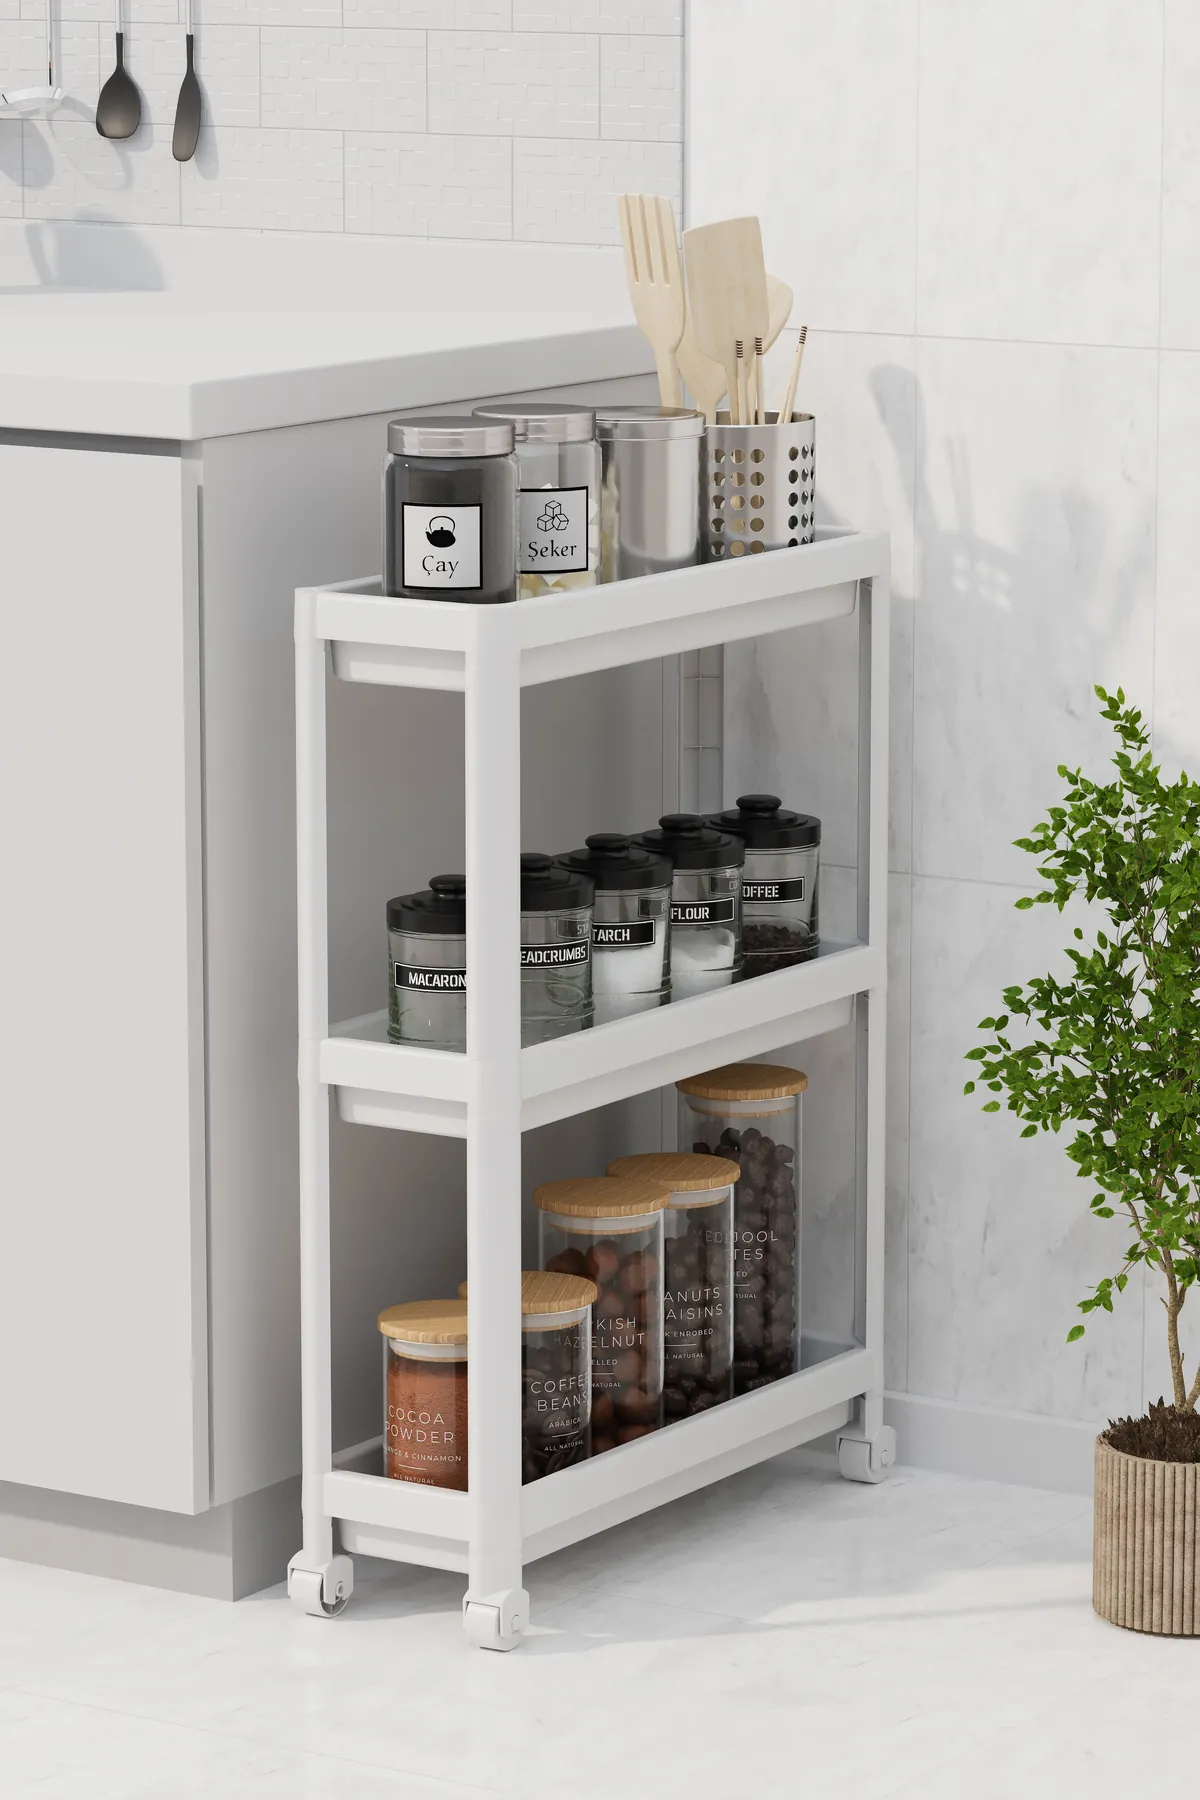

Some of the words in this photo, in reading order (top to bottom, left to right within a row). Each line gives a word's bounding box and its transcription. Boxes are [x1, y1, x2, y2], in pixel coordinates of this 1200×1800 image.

[528, 540, 577, 561] Şeker
[422, 555, 459, 578] Çay
[742, 885, 779, 898] OFFEE
[671, 907, 709, 920] FLOUR
[592, 928, 630, 942] TARCH
[520, 945, 586, 964] EADCRUMBS
[734, 1248, 763, 1260] TES
[664, 1286, 720, 1303] ANUTS
[665, 1303, 723, 1320] AISINS
[673, 1328, 714, 1338] ENROBED
[537, 1390, 588, 1412] BEANS
[388, 1405, 445, 1425] COCOA
[548, 1416, 581, 1429] ARABICA
[384, 1420, 454, 1444] POWDER
[543, 1444, 557, 1452] ALL
[559, 1439, 584, 1451] NATURAL
[411, 1453, 462, 1462] CINNAMON
[404, 1475, 435, 1485] NATURAL
